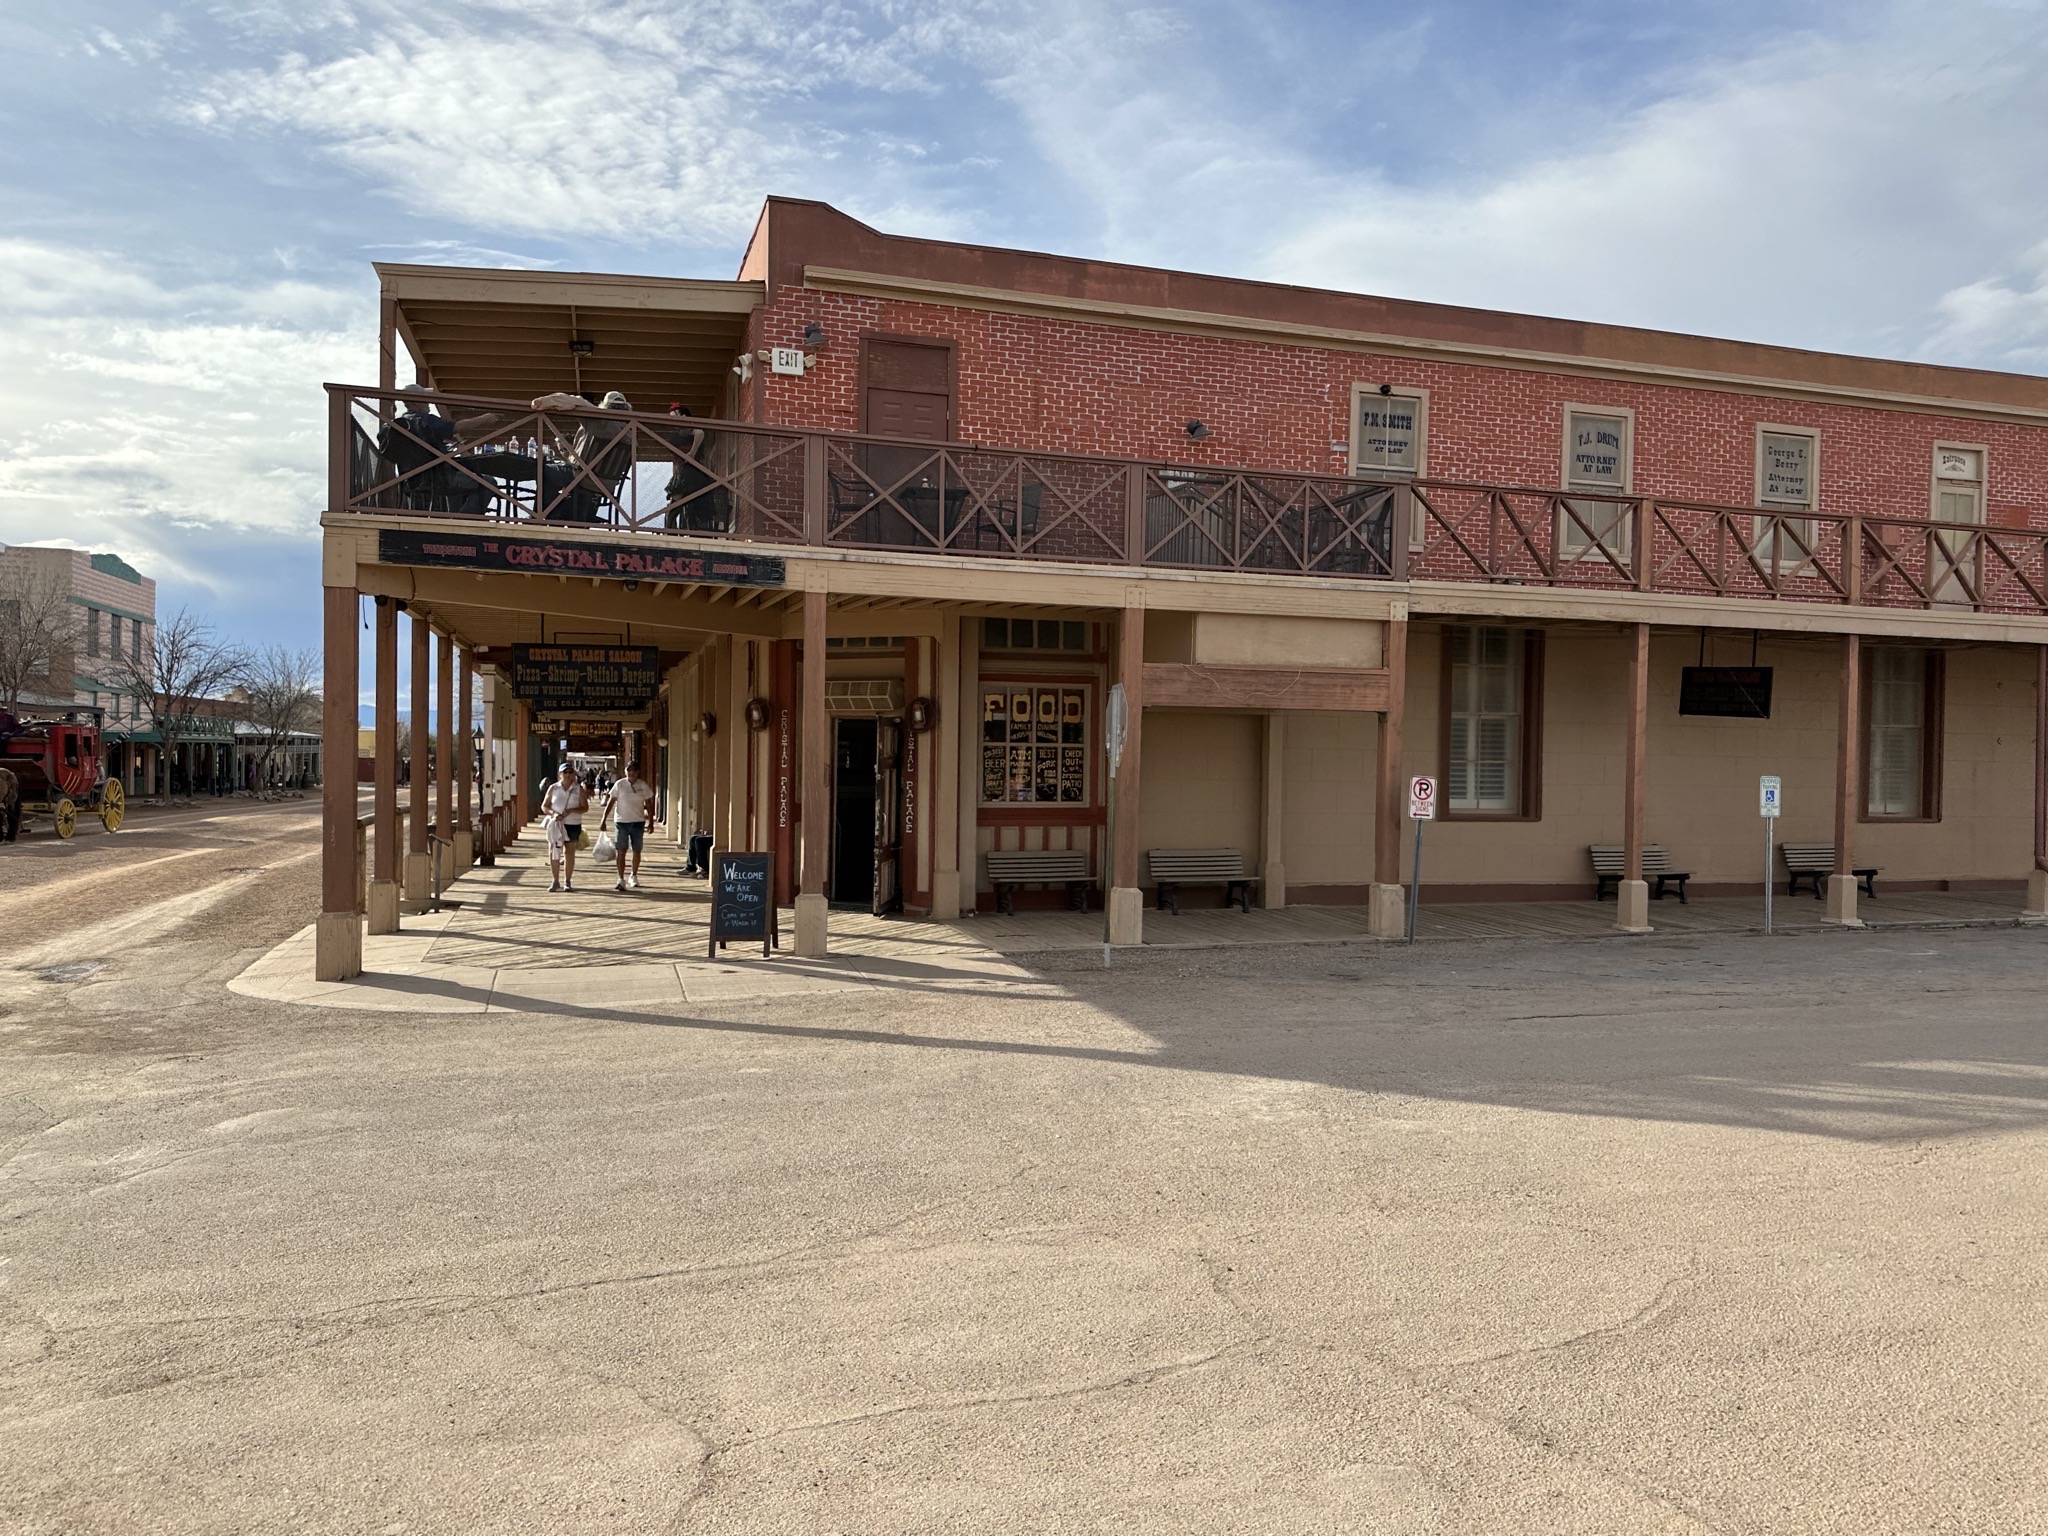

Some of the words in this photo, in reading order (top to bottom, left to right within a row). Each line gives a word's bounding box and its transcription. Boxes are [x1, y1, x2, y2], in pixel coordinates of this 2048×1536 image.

[779, 351, 798, 367] EXIT
[1364, 412, 1380, 427] F.M.
[1382, 414, 1412, 430] SMITH
[1367, 439, 1408, 447] ATTORNEY
[1597, 432, 1619, 449] DRUM
[1768, 446, 1794, 459] George
[1576, 454, 1617, 465] ATTORNEY
[1775, 458, 1799, 471] Berry
[1942, 454, 1966, 466] Entrance
[1583, 464, 1593, 472] AT
[1596, 465, 1613, 474] LAW
[1768, 473, 1804, 485] Attorney
[1769, 484, 1779, 492] At
[1785, 486, 1803, 495] Law
[482, 542, 499, 553] THE
[505, 544, 609, 570] CRYSTAL
[615, 552, 704, 577] PALACE
[529, 648, 568, 662] CRYSTAL
[572, 649, 606, 663] PALACE
[608, 651, 642, 664] SALOON
[622, 666, 655, 688] Burgers
[520, 685, 539, 695] GOOD
[542, 685, 577, 696] WHISKEY
[582, 686, 624, 697] TOLERABLE
[627, 687, 652, 697] WATER
[984, 694, 1081, 723] FOOD
[531, 723, 557, 732] ENTRANCE
[907, 728, 915, 772] YSTAL
[1010, 750, 1032, 760] ATM
[1039, 749, 1055, 758] BEST
[1064, 750, 1082, 758] CHECK
[985, 759, 1005, 768] BEER
[1065, 758, 1079, 766] OUT
[1062, 780, 1082, 789] PATIO
[780, 776, 788, 828] PALACE
[905, 780, 914, 833] PALACE
[723, 862, 764, 880] WELCOME
[737, 884, 750, 892] ARE
[736, 893, 759, 902] OPEN
